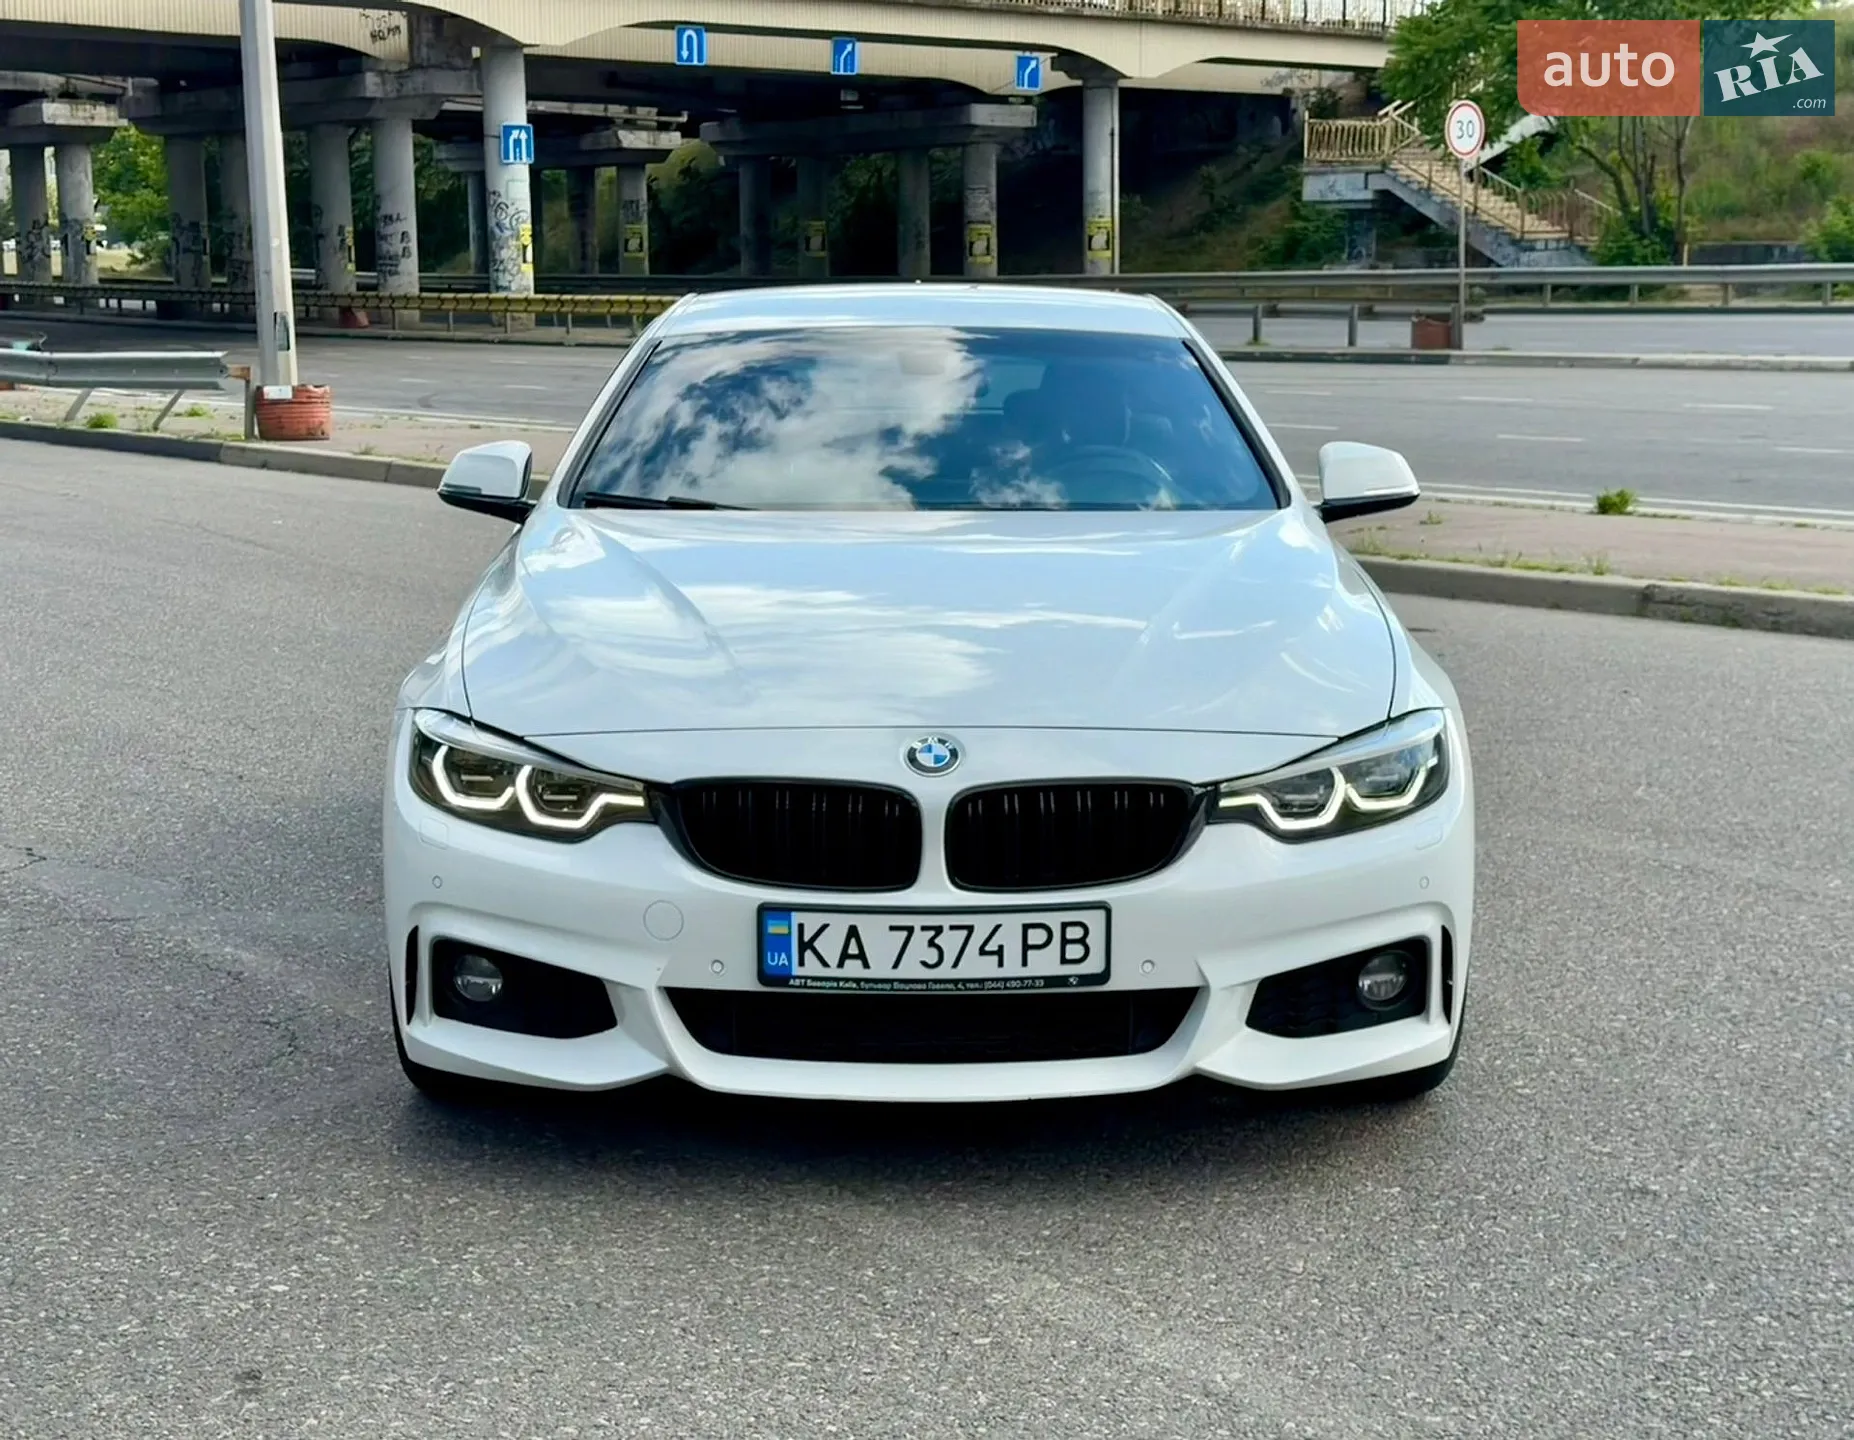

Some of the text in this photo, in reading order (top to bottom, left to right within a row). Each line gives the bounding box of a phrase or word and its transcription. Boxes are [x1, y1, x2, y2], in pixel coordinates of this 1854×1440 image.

[1456, 119, 1476, 140] 30
[796, 920, 1091, 970] KA 7374 PB
[767, 951, 789, 967] UA
